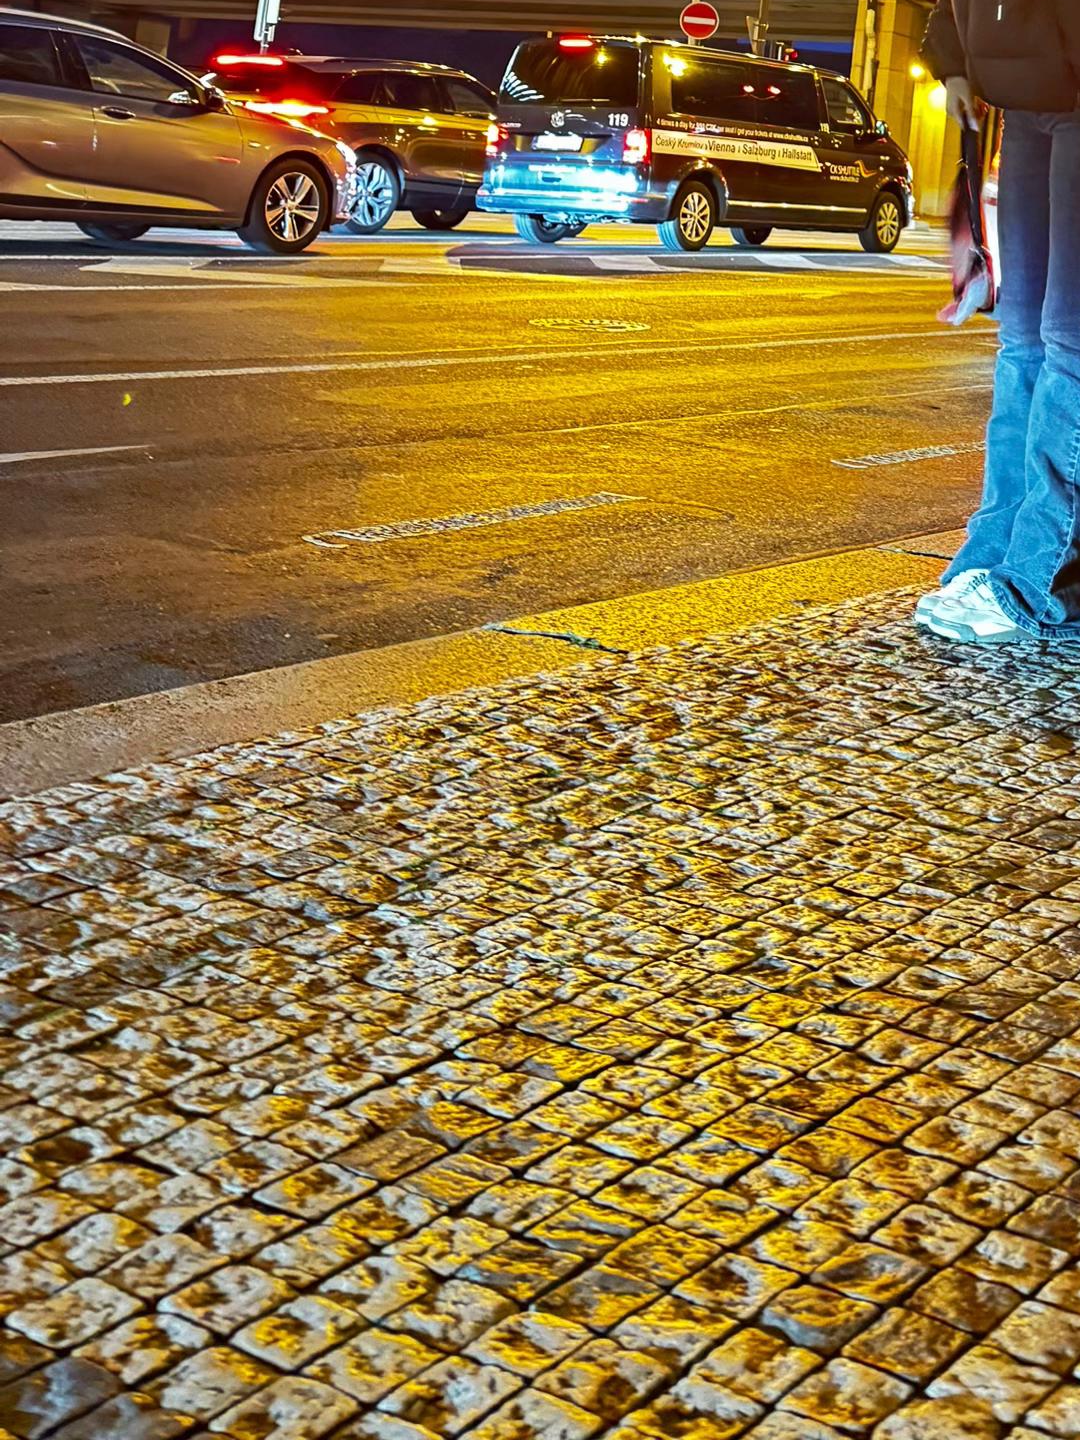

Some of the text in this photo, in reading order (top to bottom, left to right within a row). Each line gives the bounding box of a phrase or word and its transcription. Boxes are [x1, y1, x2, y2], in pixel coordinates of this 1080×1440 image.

[608, 113, 629, 127] 119
[656, 135, 676, 150] Český
[708, 140, 735, 153] Vienna
[742, 143, 776, 160] Salzburg
[782, 148, 812, 161] Hallstatt
